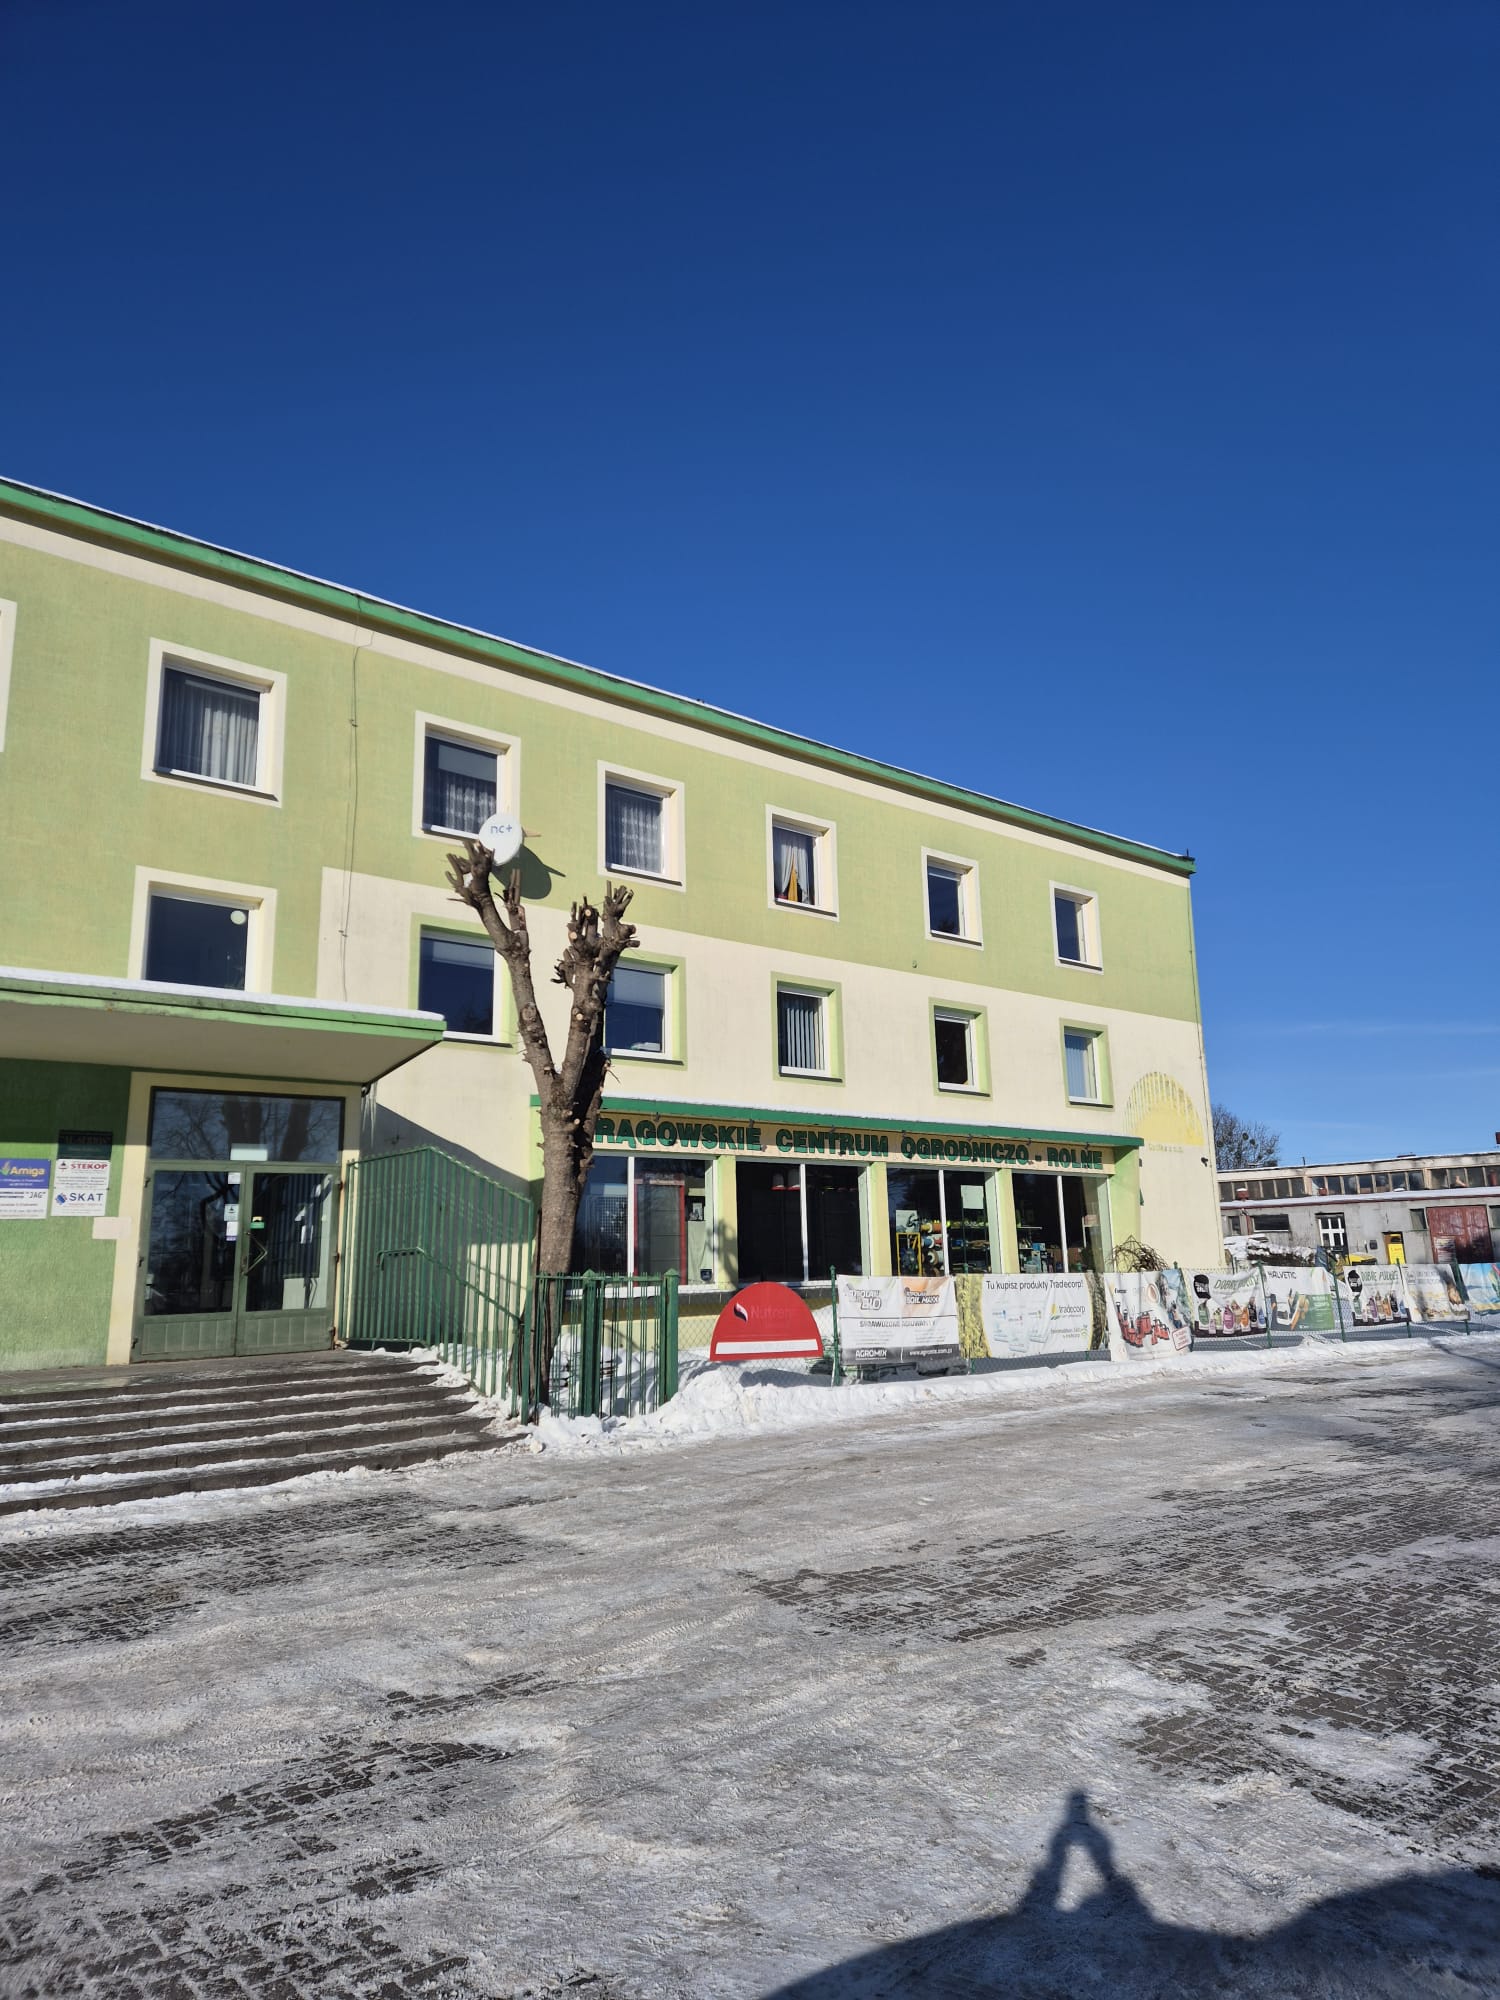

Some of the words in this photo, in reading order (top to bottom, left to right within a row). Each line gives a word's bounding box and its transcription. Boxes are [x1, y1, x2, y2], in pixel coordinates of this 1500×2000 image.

[490, 824, 513, 835] nc+
[594, 1118, 762, 1151] RĄGOWSKIE
[776, 1129, 888, 1157] CENTRUM
[901, 1136, 1029, 1165] OGRODNICZO
[1047, 1147, 1104, 1170] ROLNE
[10, 1166, 45, 1177] Amiga
[69, 1192, 104, 1202] SKAT
[986, 1281, 995, 1290] Tu
[995, 1281, 1018, 1291] kupisz
[1020, 1280, 1049, 1291] produkty
[1058, 1304, 1086, 1315] tradecorp
[855, 1350, 888, 1358] AGROMIX
